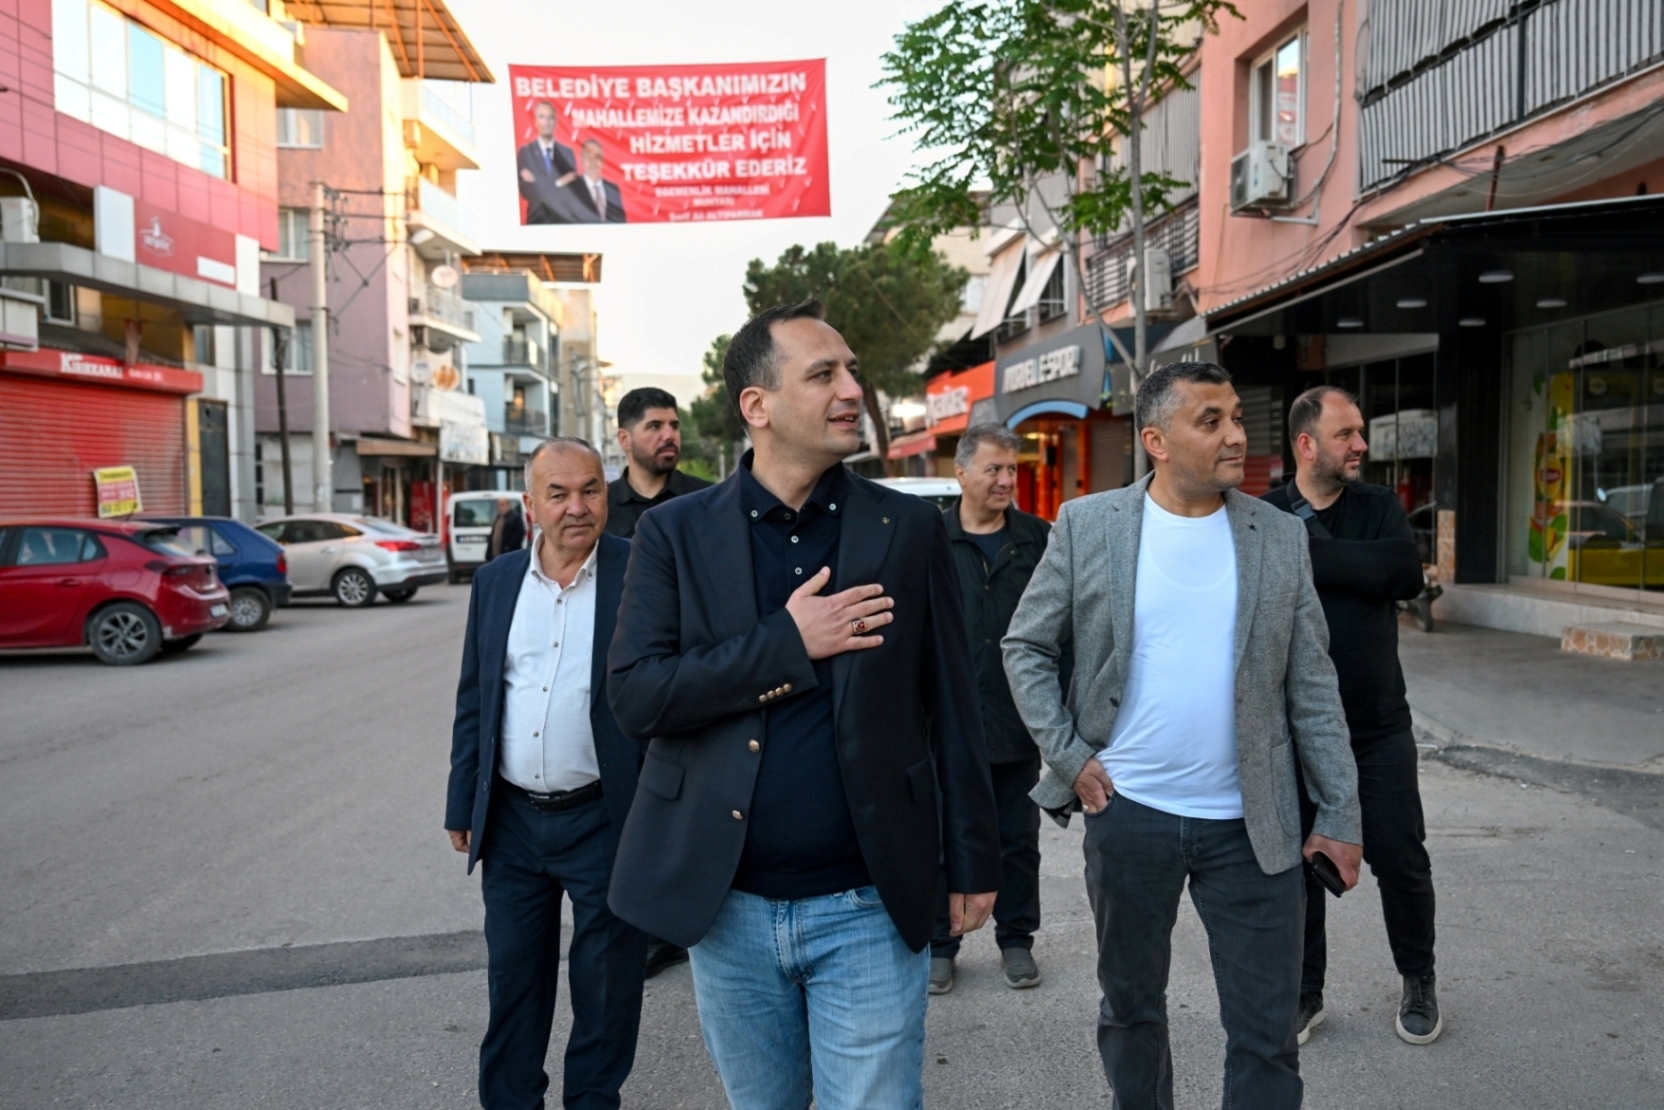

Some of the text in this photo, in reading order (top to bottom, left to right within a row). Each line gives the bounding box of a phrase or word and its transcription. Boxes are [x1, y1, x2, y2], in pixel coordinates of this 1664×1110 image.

[515, 72, 806, 101] BELEDİYE BAŞKANIMIZIN
[571, 99, 799, 128] MAHALLEMİZE KAZANDIRDIĞI
[630, 126, 791, 154] HİZMETLER İÇİN
[621, 154, 807, 185] TEŞEKKÜR EDERİZ
